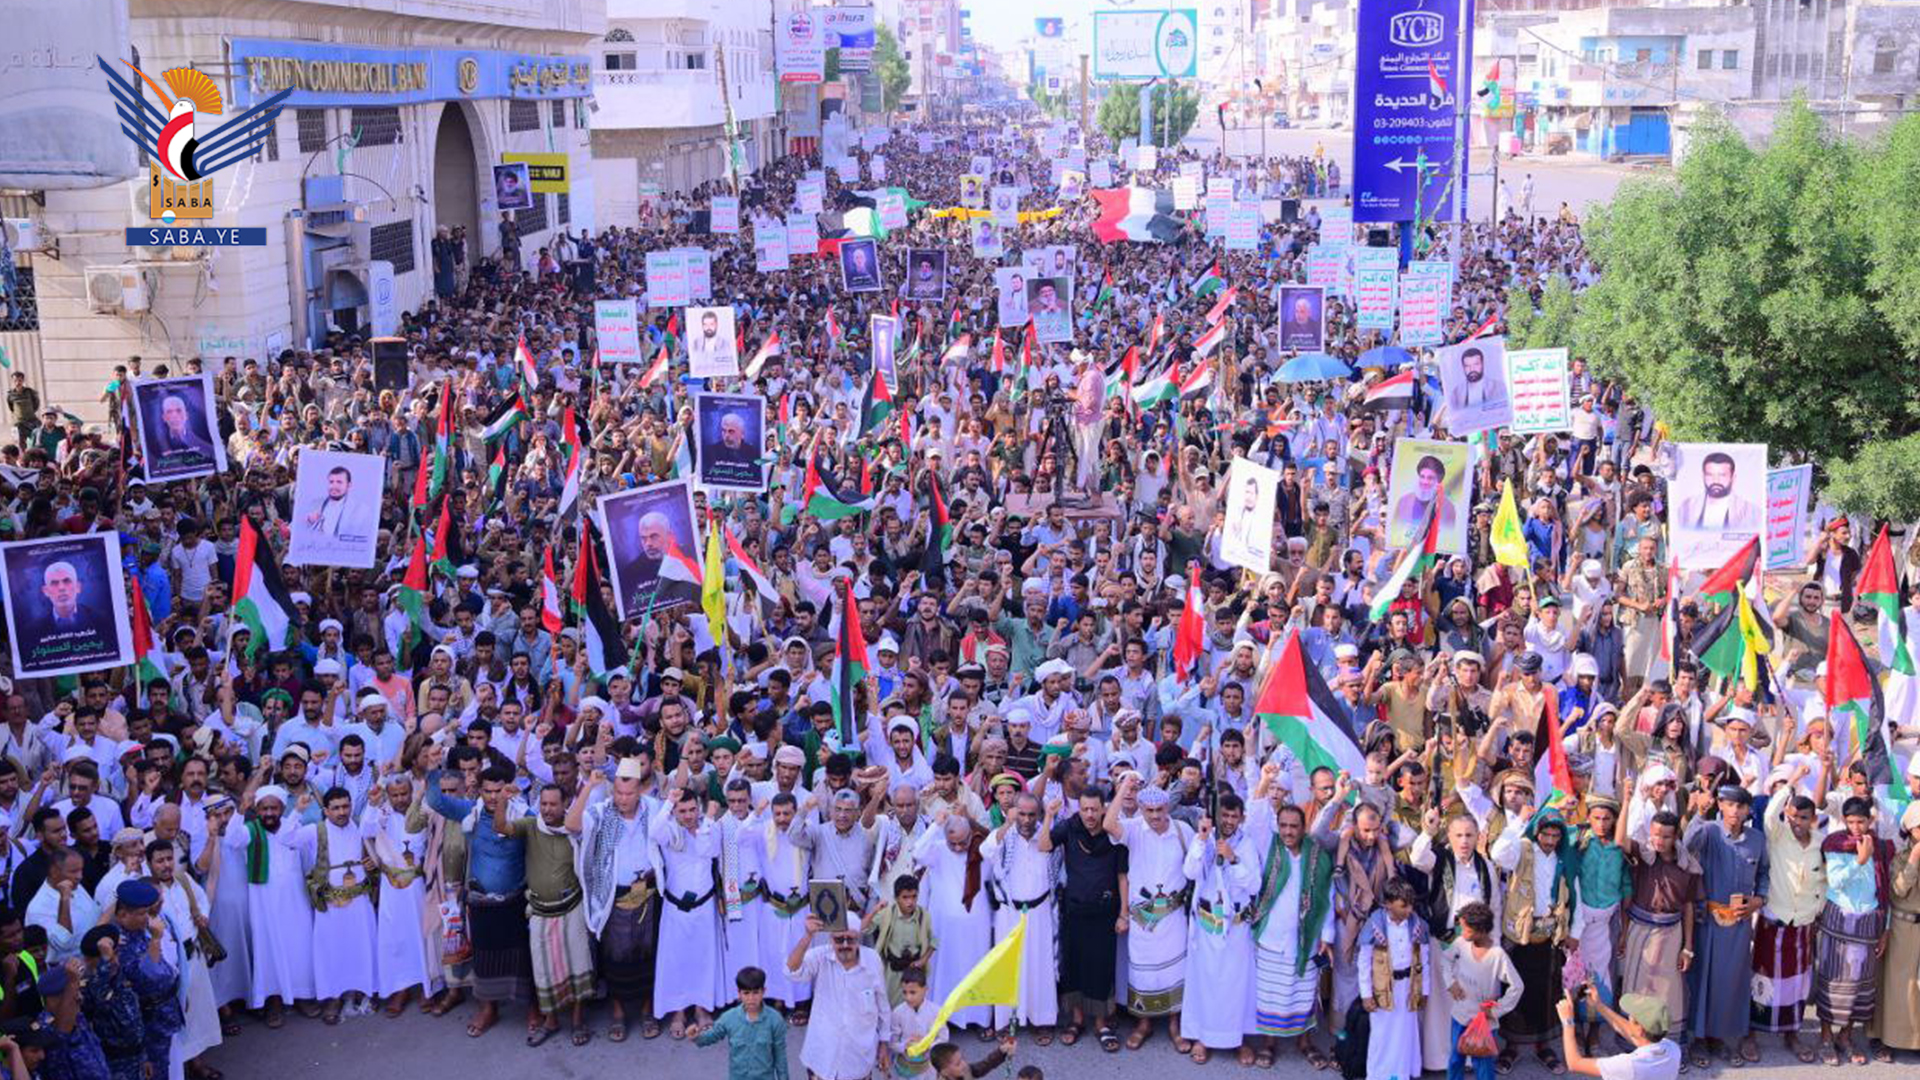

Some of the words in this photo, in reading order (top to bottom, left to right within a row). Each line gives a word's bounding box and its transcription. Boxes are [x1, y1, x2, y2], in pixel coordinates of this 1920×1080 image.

[1396, 16, 1439, 42] YCB
[244, 57, 306, 91] YEMEN
[308, 60, 397, 93] COMMERCIAL
[398, 63, 428, 91] BANK
[1375, 93, 1427, 110] الحديدة
[31, 641, 71, 658] السنوار
